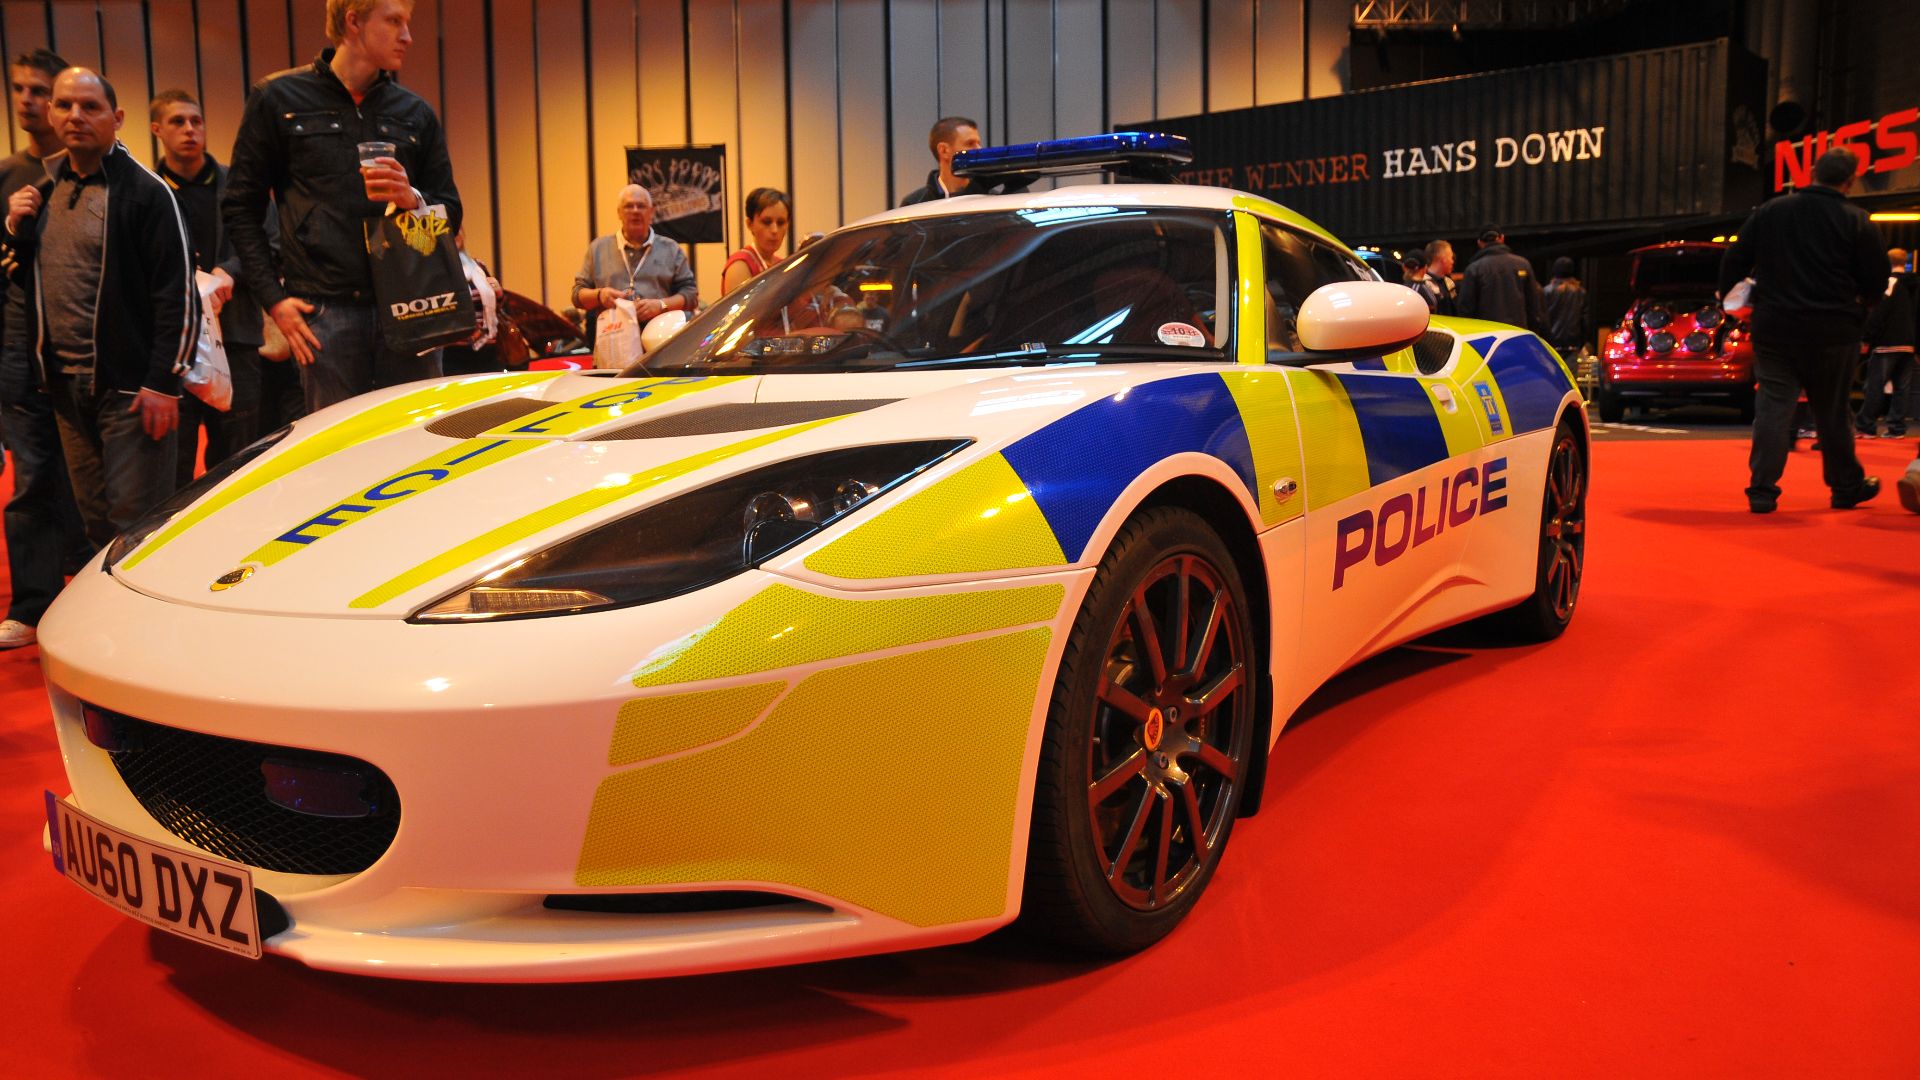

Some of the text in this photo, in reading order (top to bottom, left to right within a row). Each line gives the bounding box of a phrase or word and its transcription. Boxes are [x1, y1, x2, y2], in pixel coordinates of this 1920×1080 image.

[1179, 126, 1605, 191] THE WINNER HANS DOWN
[390, 292, 458, 318] DOTZ
[273, 376, 709, 545] POLICE
[1332, 456, 1508, 592] POLICE
[64, 812, 250, 946] AU60 DXZ
